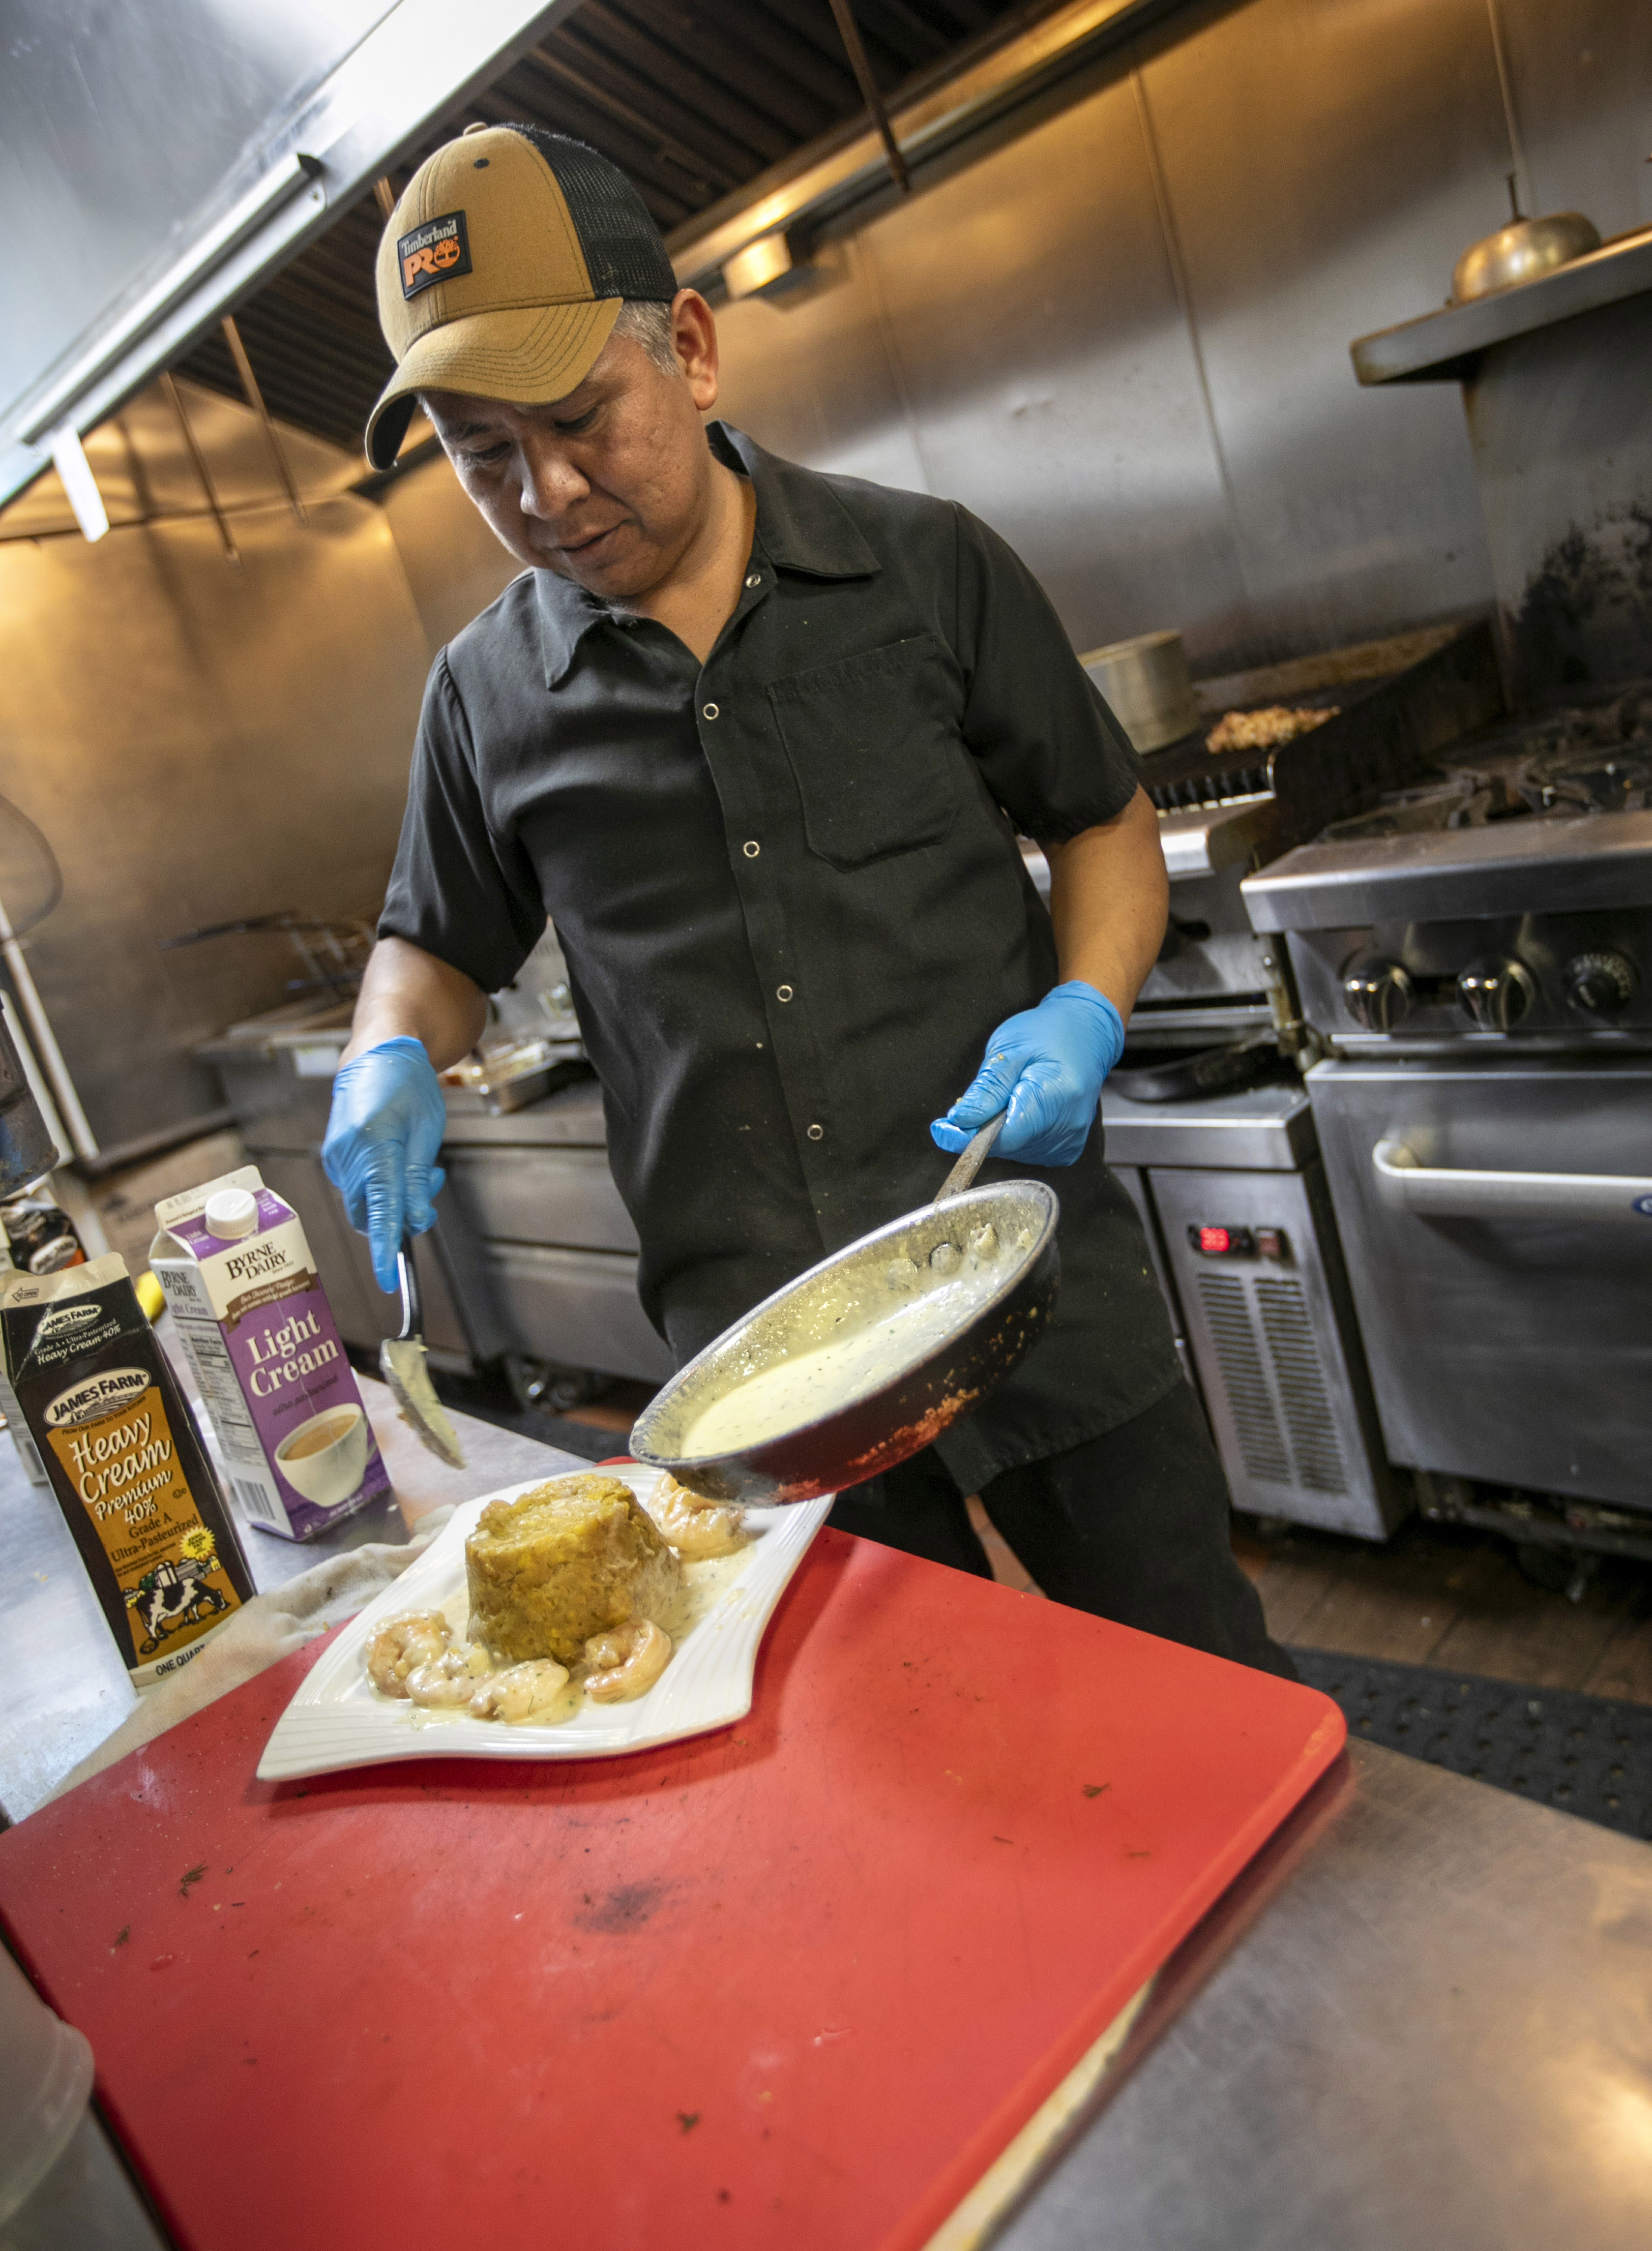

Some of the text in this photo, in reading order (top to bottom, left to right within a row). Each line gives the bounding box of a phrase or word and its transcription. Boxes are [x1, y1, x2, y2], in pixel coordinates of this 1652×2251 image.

[401, 219, 458, 257] Timberland
[161, 1270, 190, 1288] BYRNE
[225, 1242, 275, 1279] BYRNE
[246, 1250, 286, 1279] DAIRY
[173, 1284, 197, 1296] DAIRY
[70, 1308, 98, 1321] FARM
[34, 1343, 54, 1355] Grade
[37, 1348, 68, 1365] Heavy
[69, 1335, 102, 1353] Cream
[103, 1323, 121, 1338] 40%
[246, 1310, 321, 1365] Light
[250, 1339, 339, 1397] Cream
[54, 1375, 144, 1421] JAMES FARM
[68, 1412, 150, 1473] Heavy
[80, 1440, 171, 1503] Cream
[95, 1470, 172, 1521] Premium
[124, 1496, 157, 1524] 40%
[111, 1513, 199, 1562] Ultra-Pasteurized
[129, 1512, 172, 1539] Grade A
[156, 1659, 176, 1676] ONE
